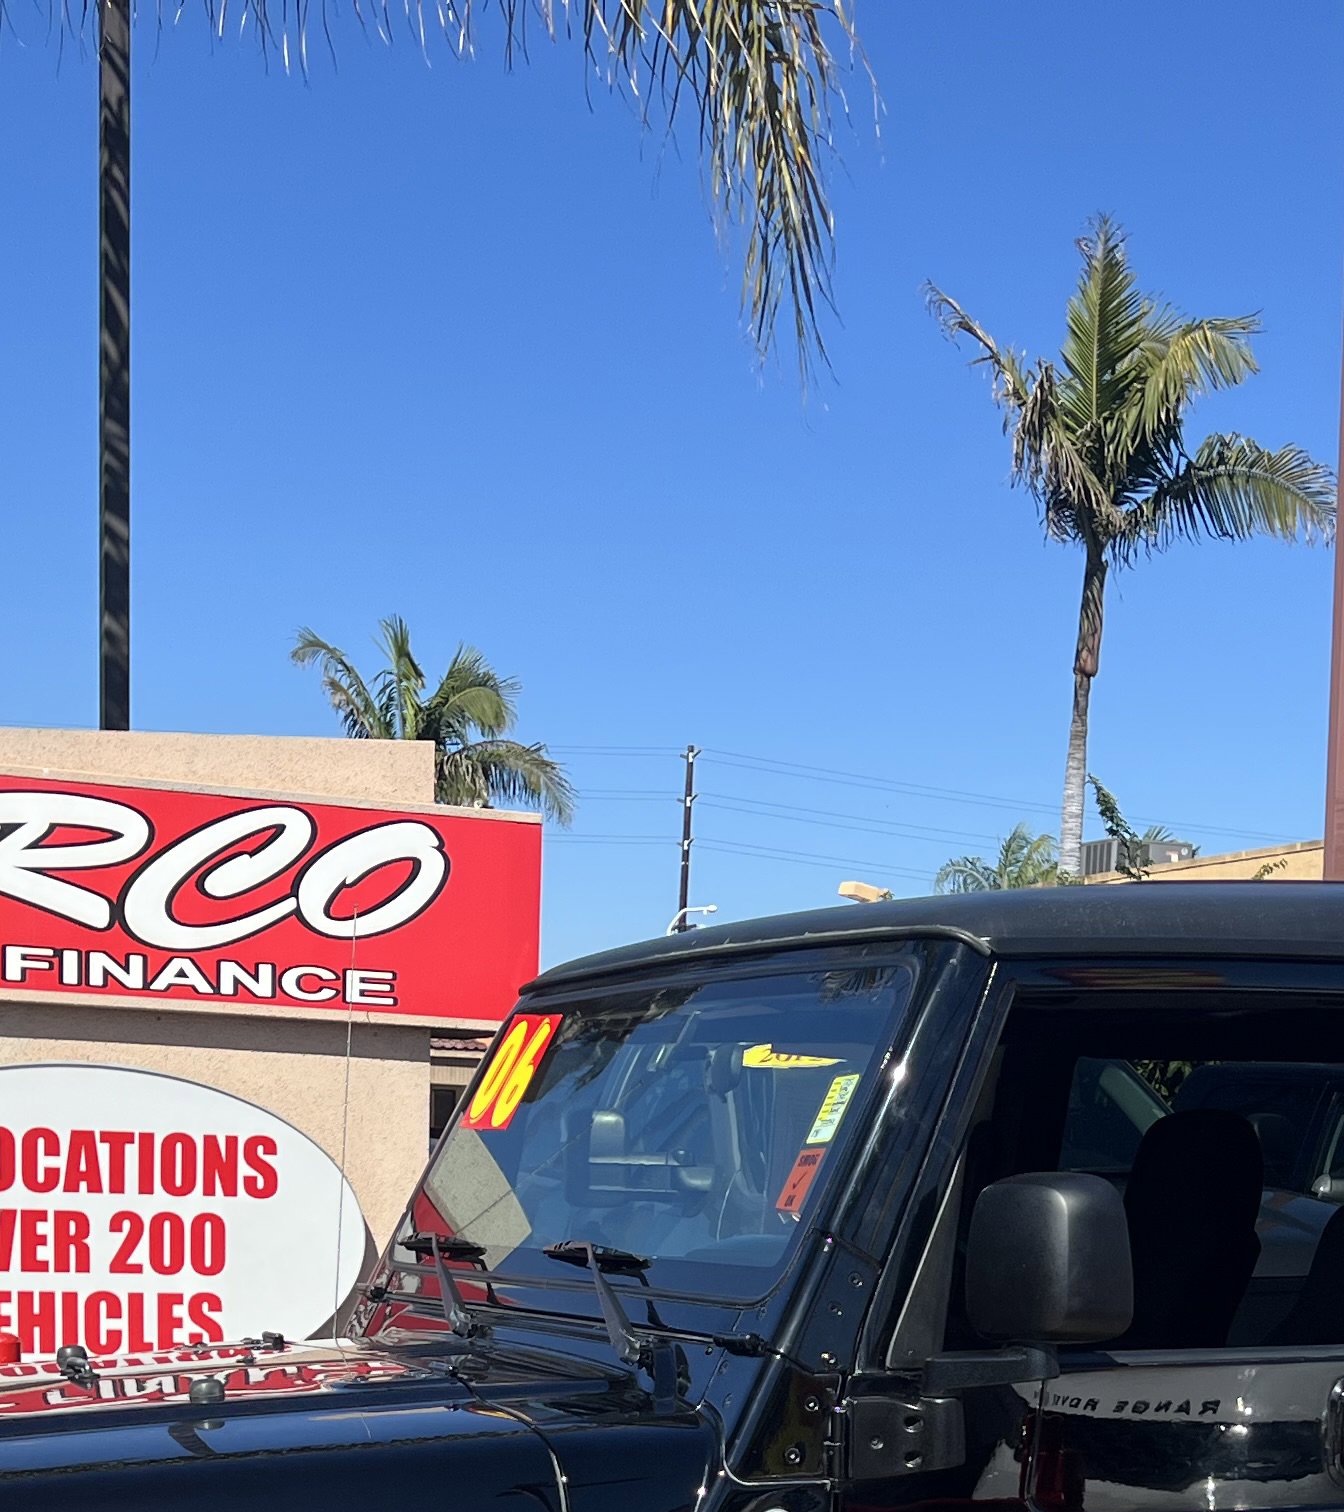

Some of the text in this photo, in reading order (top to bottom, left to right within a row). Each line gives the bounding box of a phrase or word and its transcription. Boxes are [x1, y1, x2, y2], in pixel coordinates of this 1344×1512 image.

[3, 945, 397, 1005] FINANCE
[468, 1018, 550, 1127] 06
[109, 1210, 226, 1276] 200
